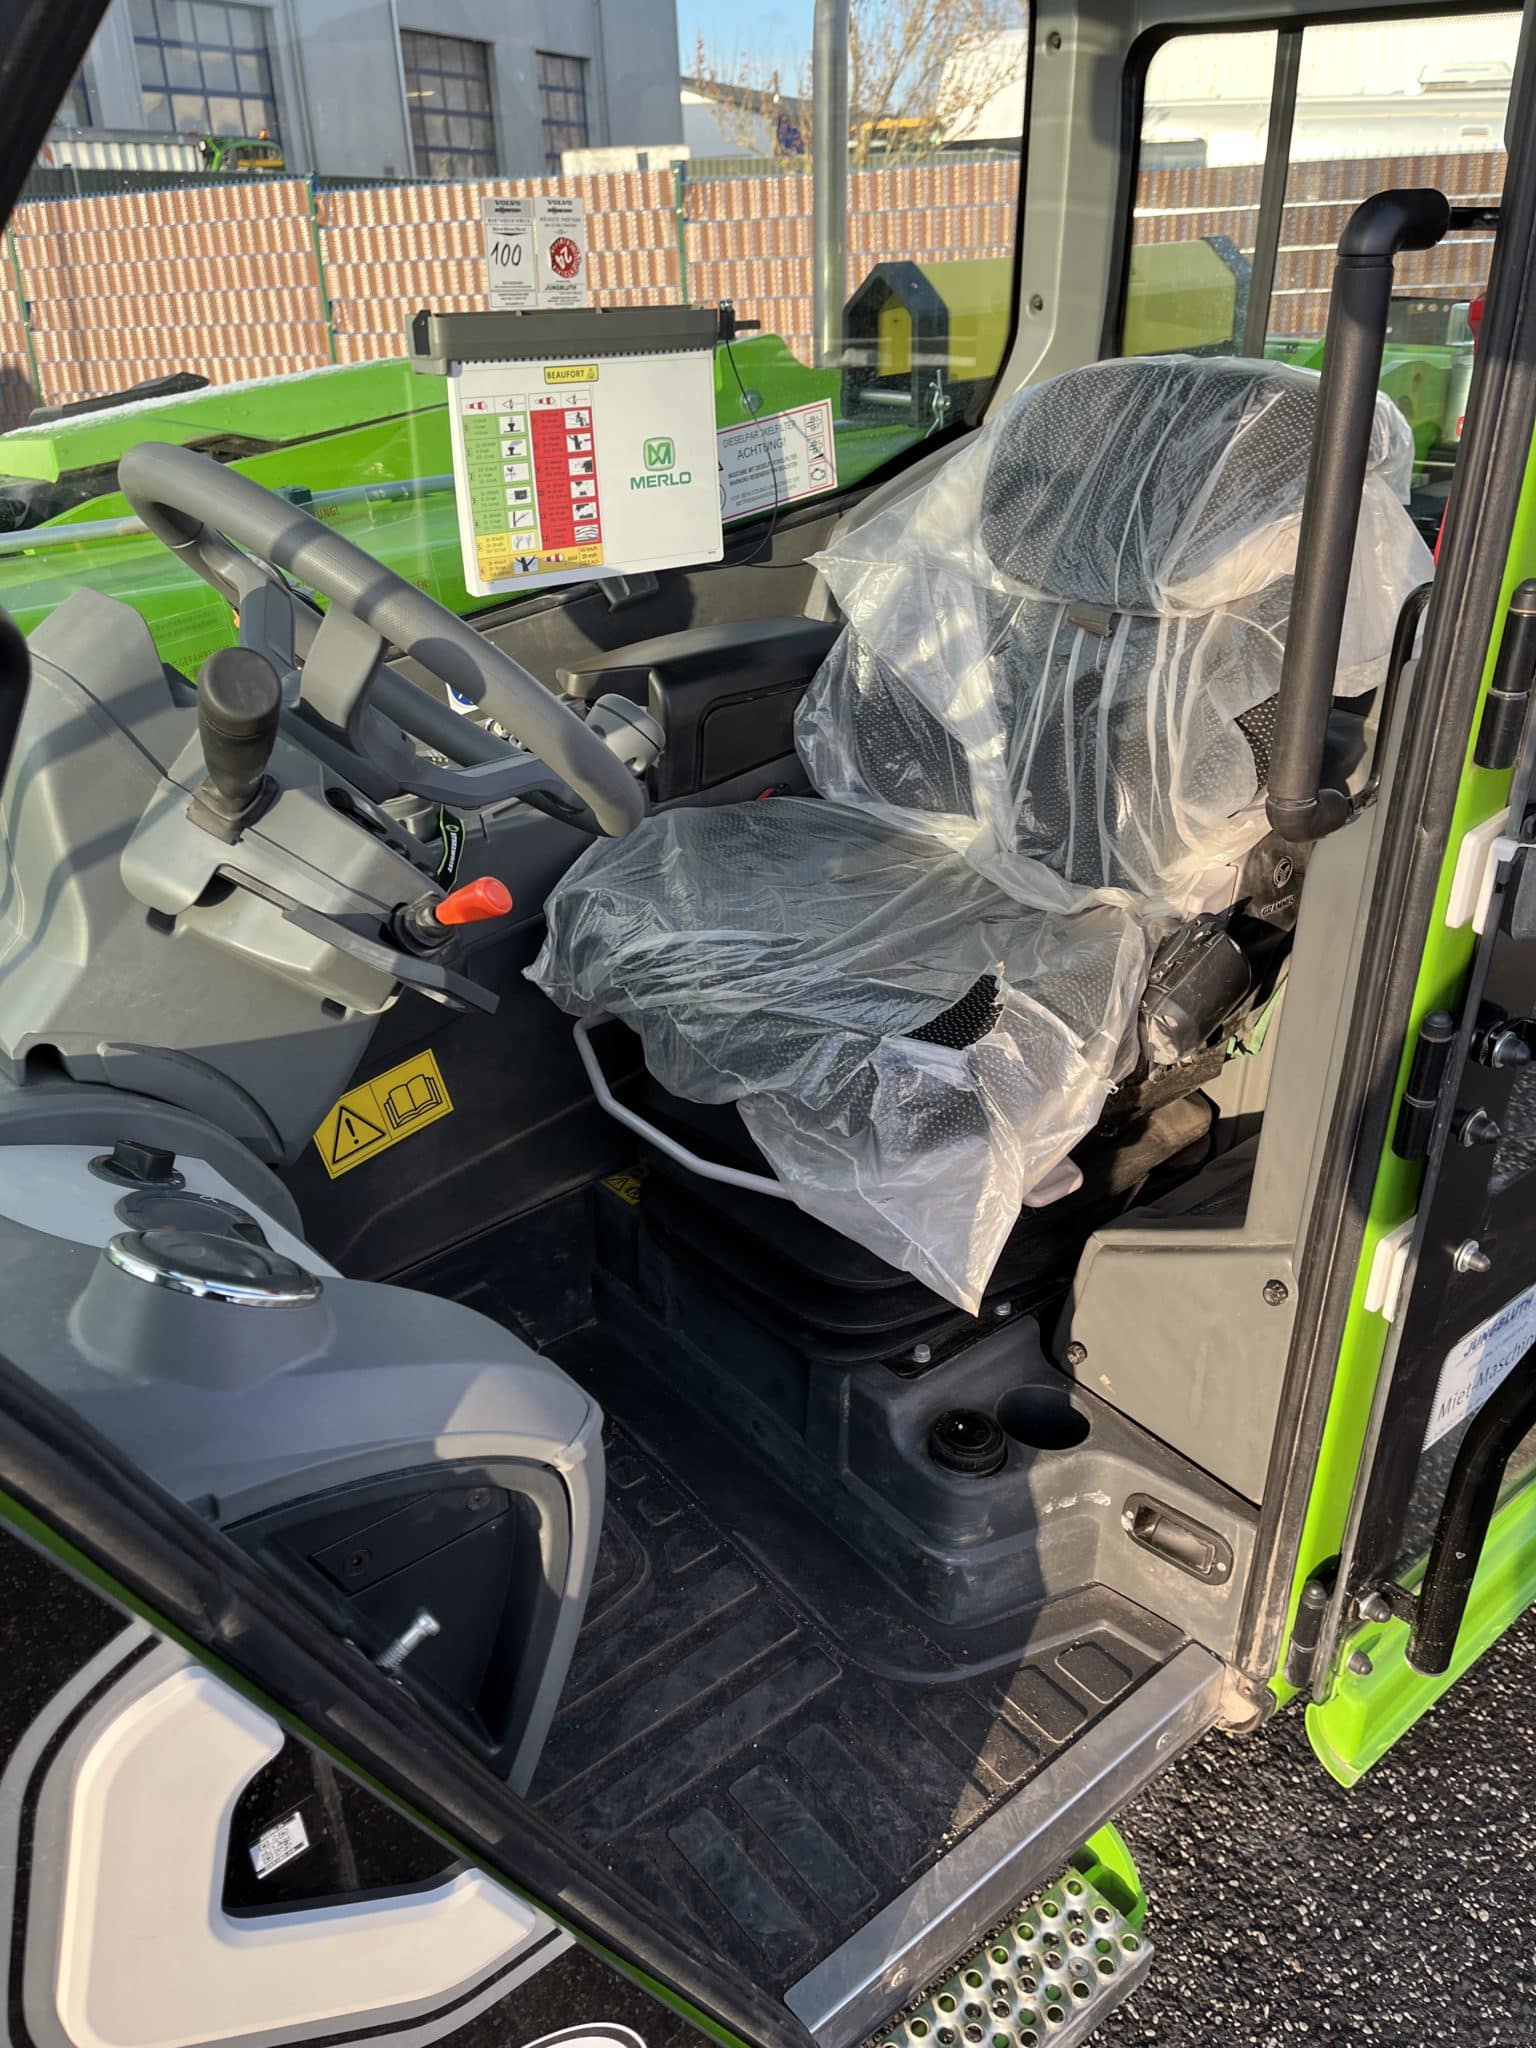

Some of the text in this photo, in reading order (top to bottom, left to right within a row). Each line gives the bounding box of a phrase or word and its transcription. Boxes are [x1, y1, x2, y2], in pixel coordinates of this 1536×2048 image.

[490, 241, 522, 267] 100
[546, 369, 585, 380] BEAUFORT
[630, 471, 692, 490] MERLO
[1463, 1292, 1535, 1358] JUNGBLUTH
[1437, 1332, 1536, 1423] Miet-Maschin
